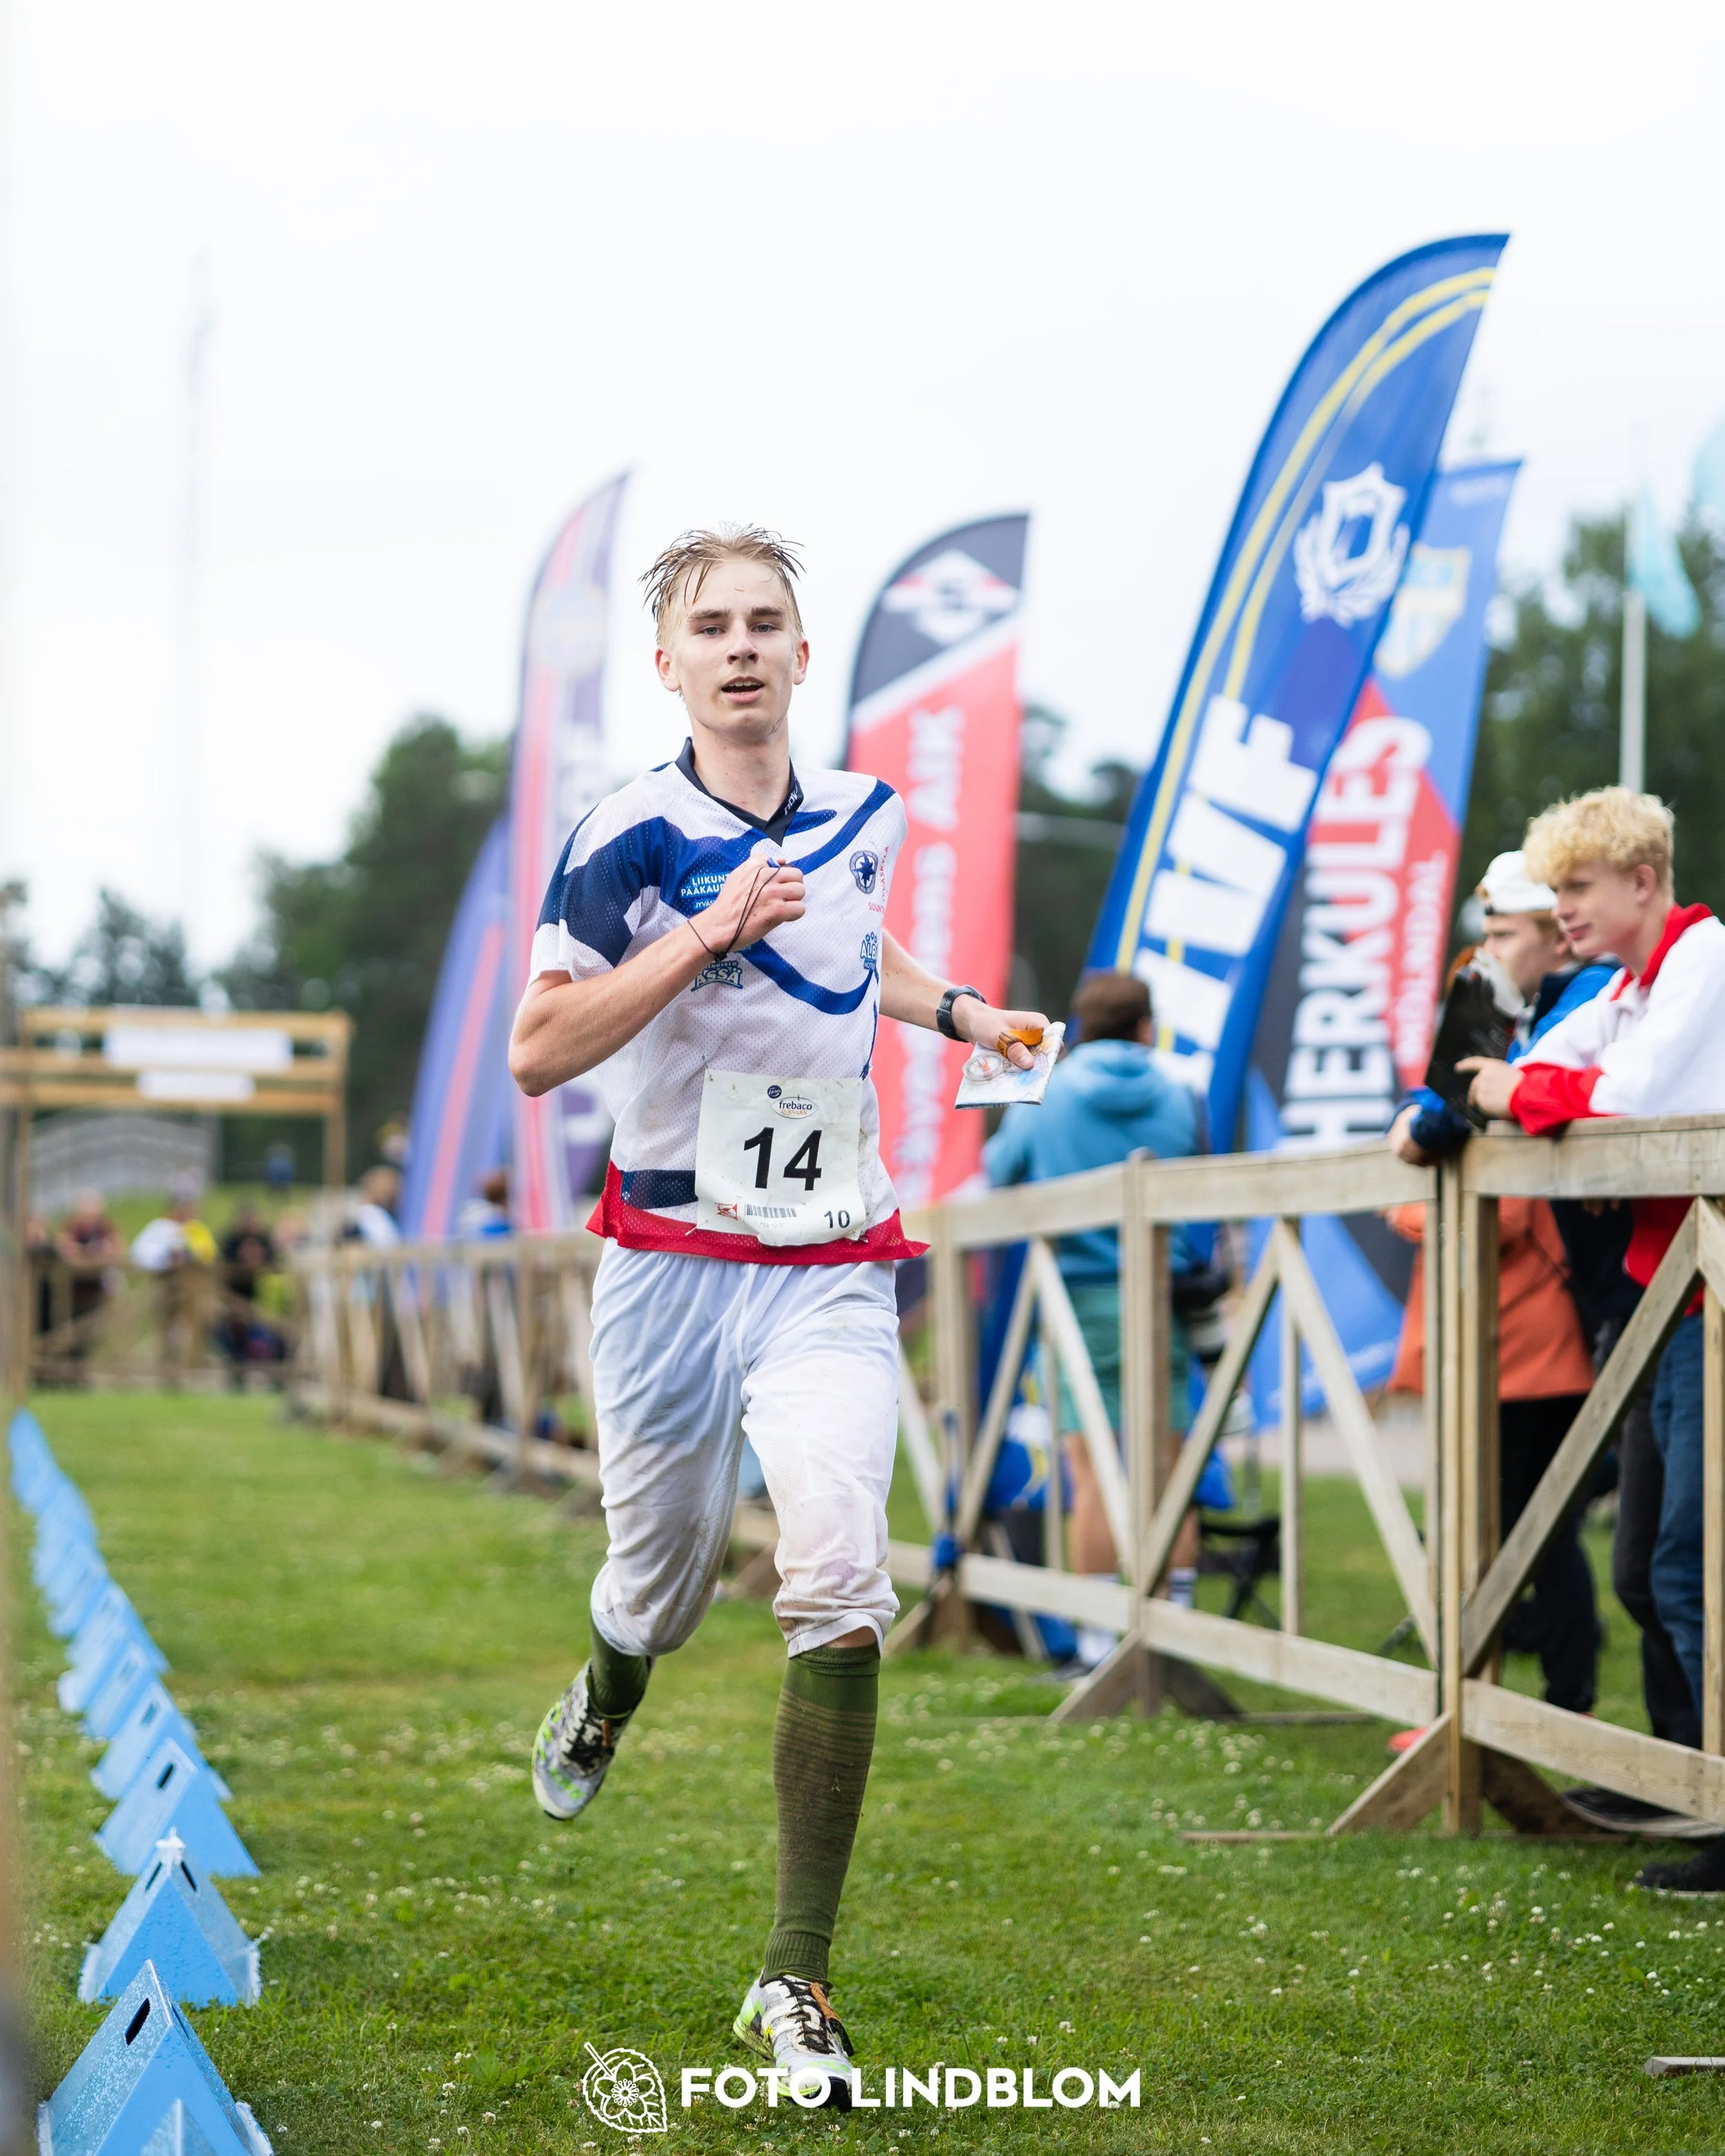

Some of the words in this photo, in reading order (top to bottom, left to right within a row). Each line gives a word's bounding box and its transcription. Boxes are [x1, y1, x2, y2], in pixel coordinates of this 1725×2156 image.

[694, 899, 716, 909] JYVÄS
[1274, 715, 1433, 1155] HERKULES
[860, 939, 878, 960] ALB
[779, 1100, 813, 1110] frebaco
[743, 1127, 822, 1191] 14
[823, 1209, 851, 1229] 10
